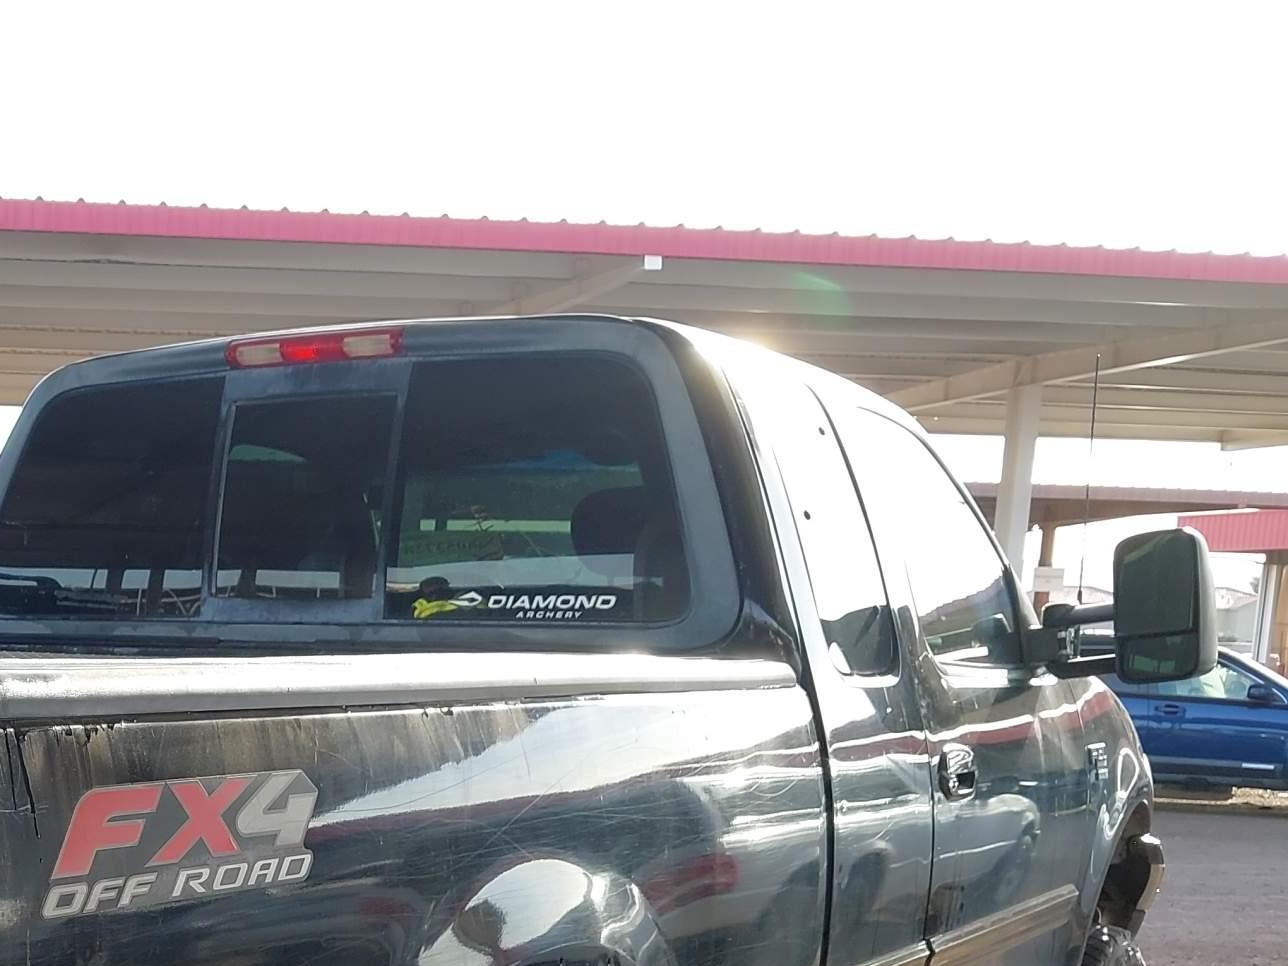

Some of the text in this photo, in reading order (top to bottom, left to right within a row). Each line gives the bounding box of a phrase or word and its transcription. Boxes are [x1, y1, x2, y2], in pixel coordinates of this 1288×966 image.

[487, 595, 617, 610] DIAMOND
[515, 611, 584, 619] ARCHERY
[51, 771, 319, 880] FX4
[41, 853, 313, 919] OFF ROAD
